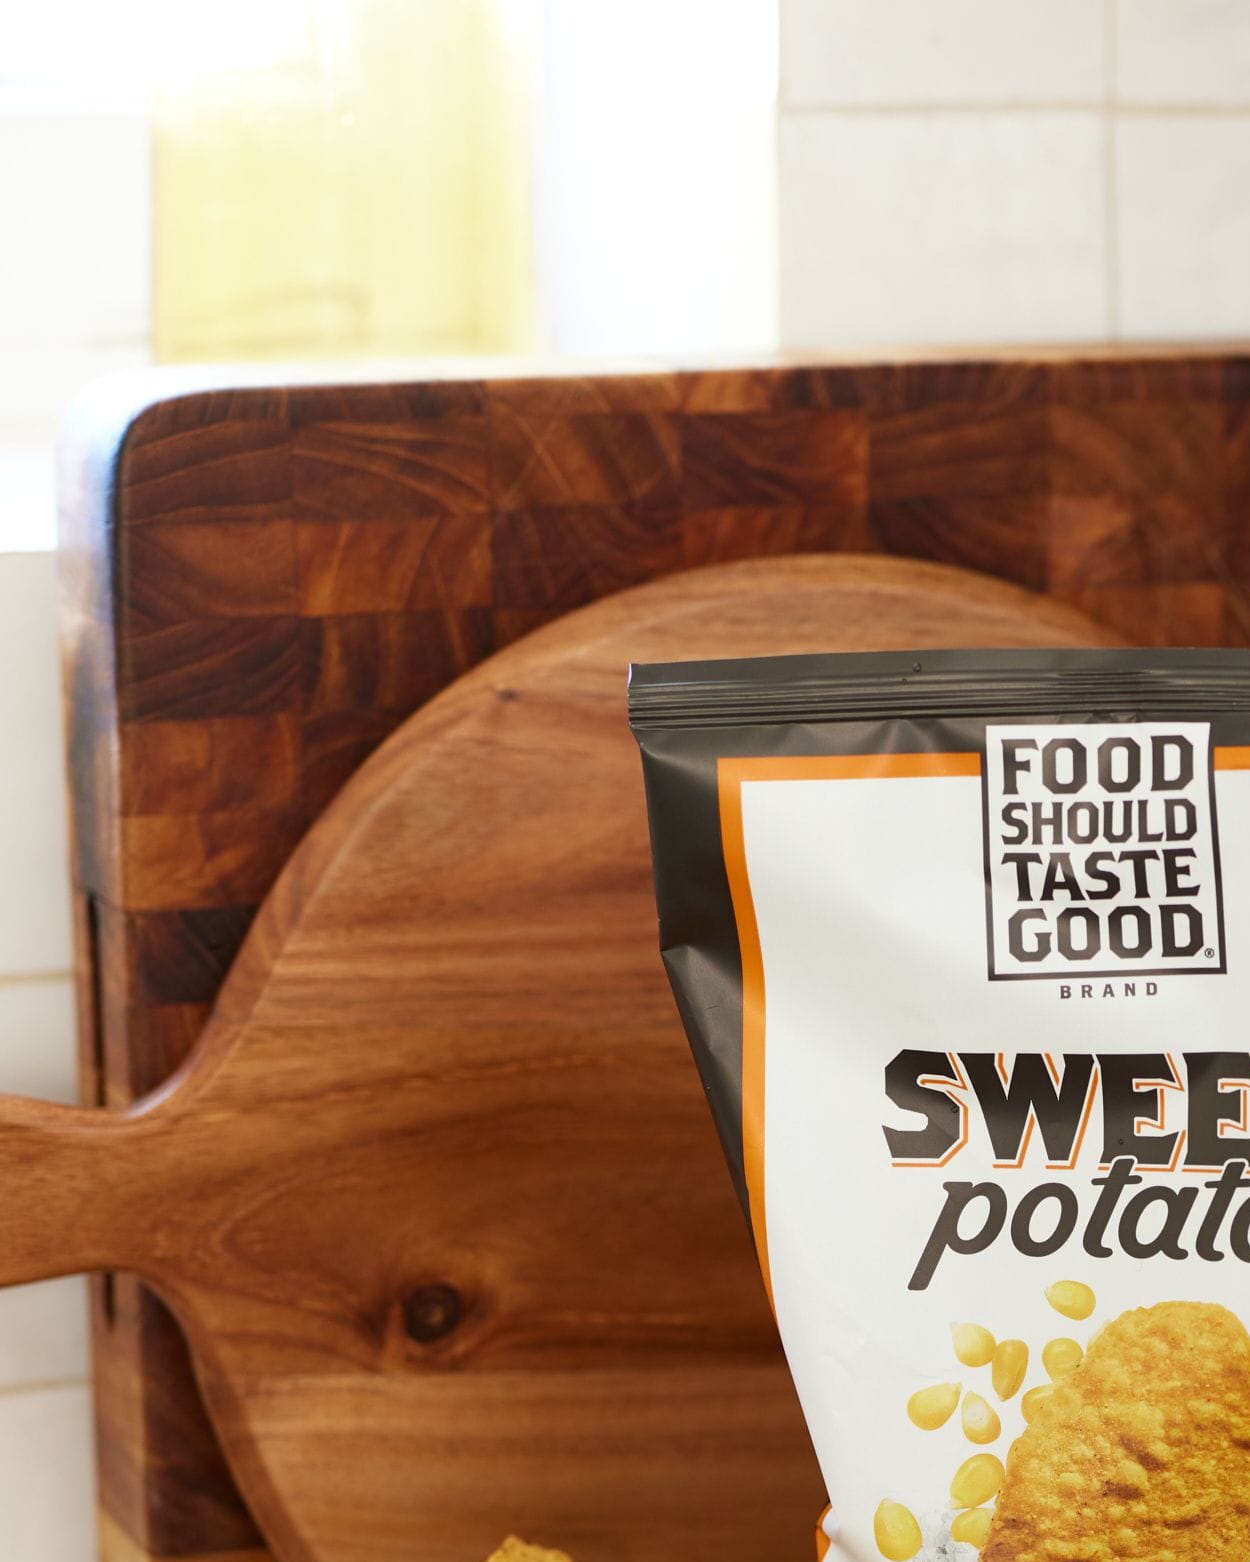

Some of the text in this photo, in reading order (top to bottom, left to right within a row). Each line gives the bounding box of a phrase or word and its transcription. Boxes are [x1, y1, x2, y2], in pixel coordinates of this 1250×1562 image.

[1000, 734, 1194, 796] FOOD
[1001, 797, 1198, 846] SHOULD
[1000, 847, 1201, 902] TASTE
[1059, 981, 1159, 1000] BRAND
